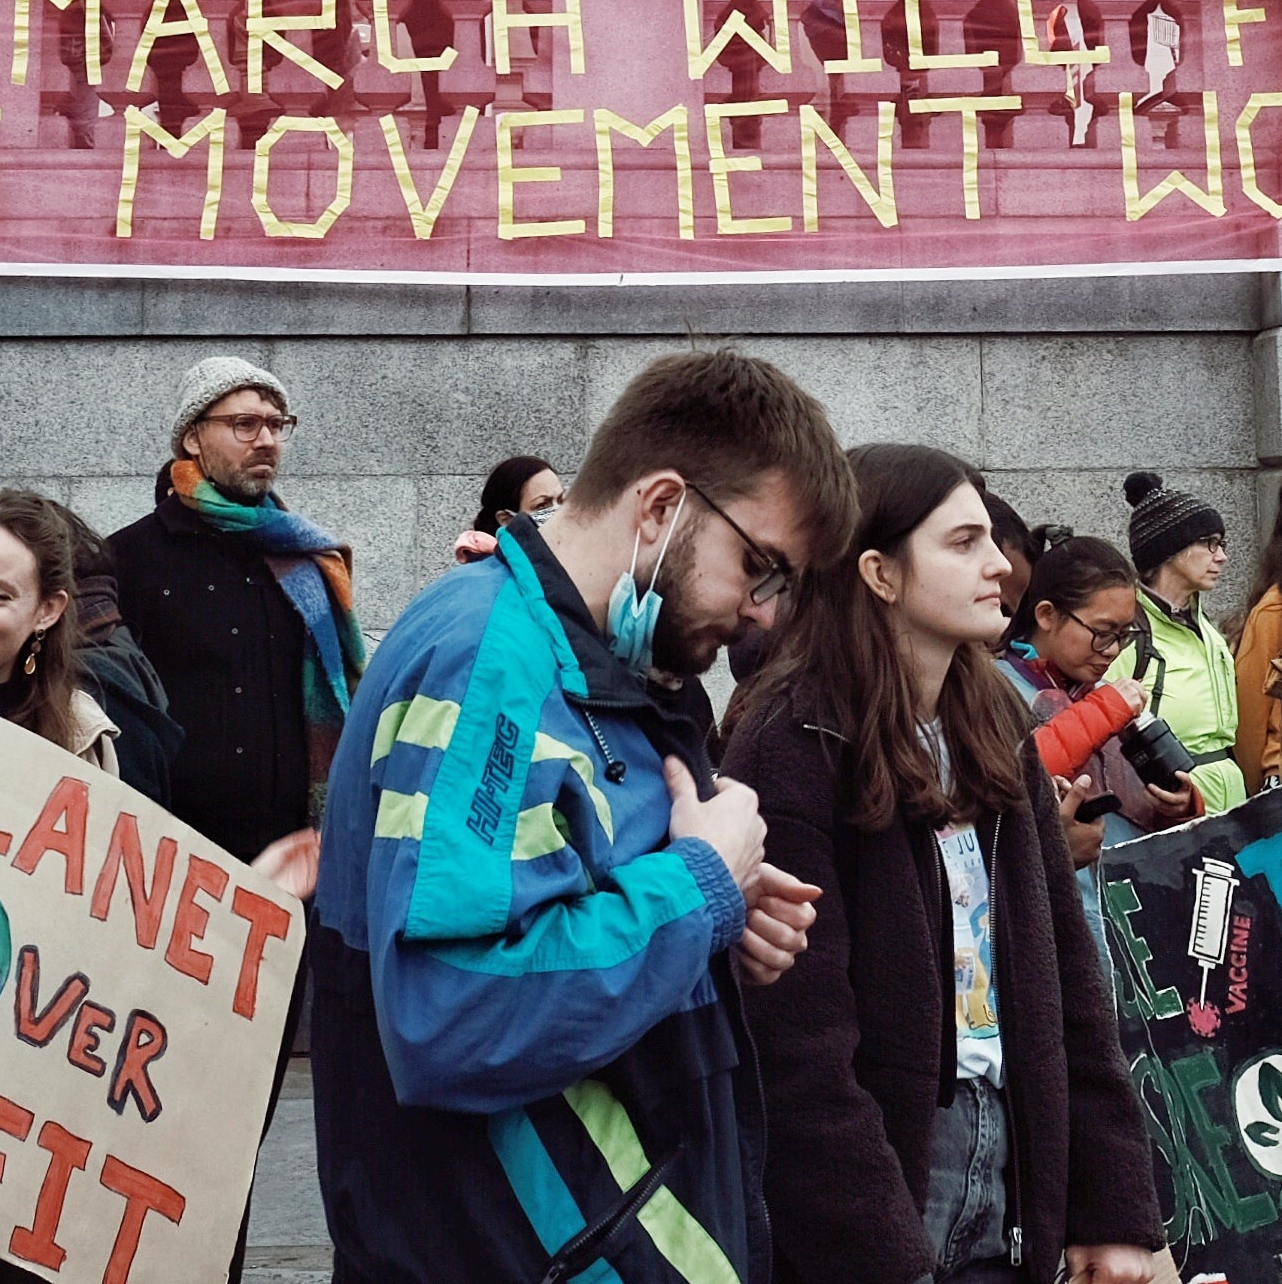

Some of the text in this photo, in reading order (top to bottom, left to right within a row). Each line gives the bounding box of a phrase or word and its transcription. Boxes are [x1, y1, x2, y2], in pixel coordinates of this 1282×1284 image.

[116, 96, 1022, 241] MOVEMENT
[465, 712, 521, 847] HI-TEC
[1225, 914, 1253, 1014] VACCINE
